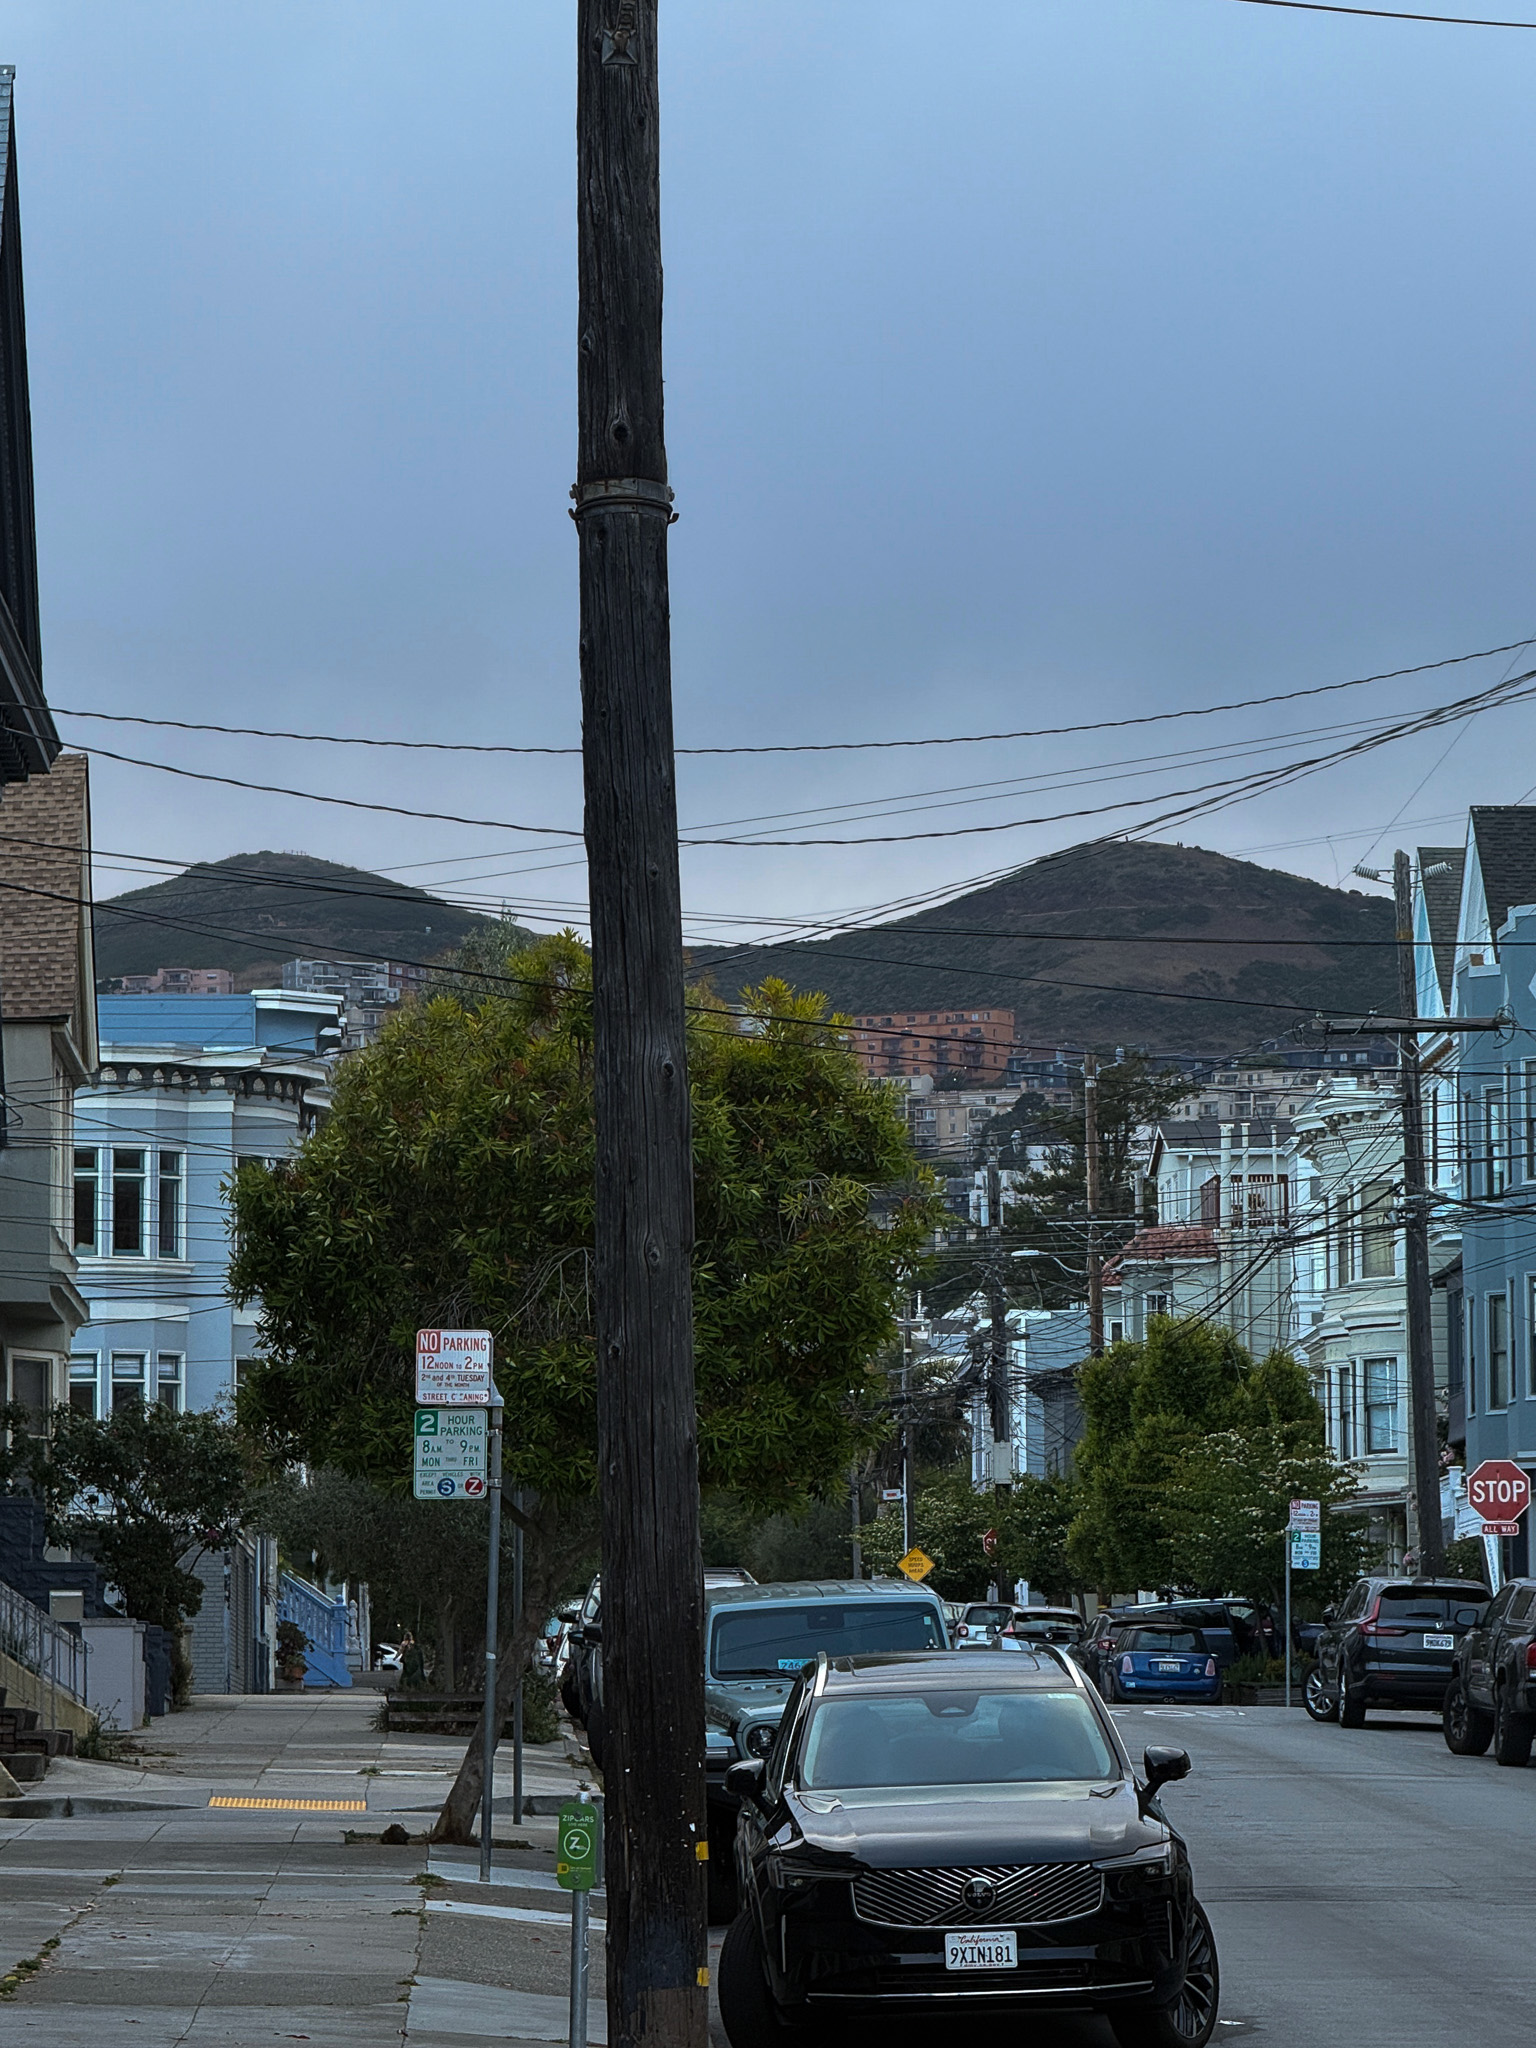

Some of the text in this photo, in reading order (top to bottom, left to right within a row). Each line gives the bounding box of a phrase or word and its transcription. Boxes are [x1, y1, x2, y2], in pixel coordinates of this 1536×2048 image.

[420, 1333, 487, 1351] NO PARKING
[457, 1374, 485, 1382] TUESDAY
[422, 1393, 484, 1401] STREET CANING
[420, 1414, 475, 1432] 2 HOUR
[440, 1426, 483, 1436] PARKING
[421, 1457, 441, 1467] MON
[463, 1456, 478, 1466] FRI
[440, 1480, 452, 1494] S
[468, 1480, 480, 1493] Z
[1472, 1480, 1526, 1503] STOP
[1484, 1525, 1516, 1533] ALL WAY
[960, 1935, 1000, 1946] California
[950, 1945, 1013, 1964] 9XIN181
